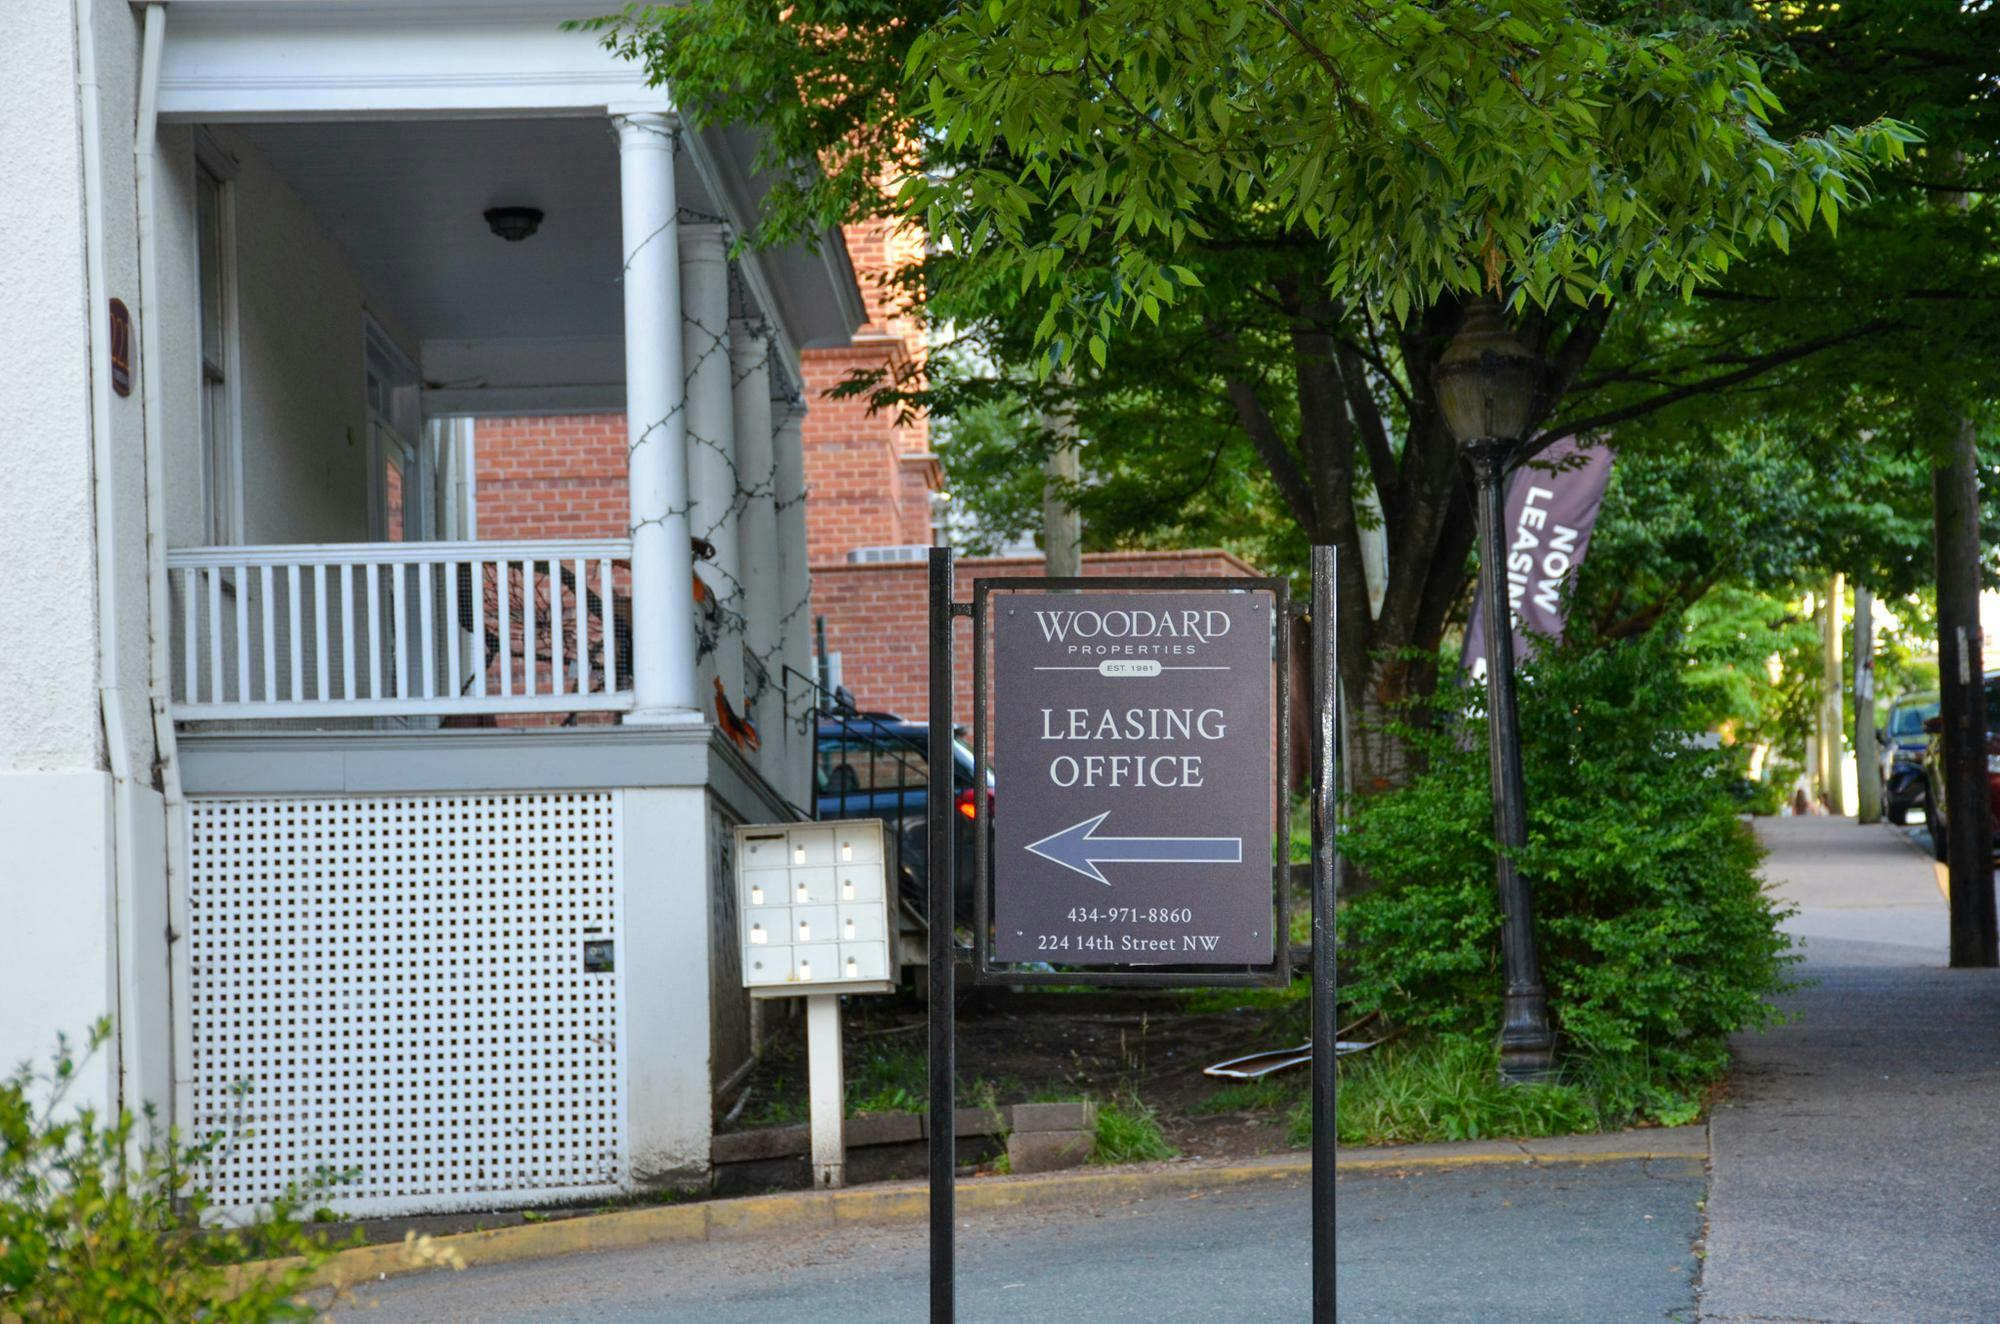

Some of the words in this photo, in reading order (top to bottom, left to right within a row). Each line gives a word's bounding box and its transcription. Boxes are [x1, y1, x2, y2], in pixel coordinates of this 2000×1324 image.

[1506, 485, 1554, 631] LEASIN
[1532, 524, 1579, 615] NOW
[1034, 610, 1231, 644] WOODARD
[1068, 645, 1196, 655] PROPERTIES
[1106, 664, 1128, 672] EST.
[1131, 664, 1154, 672] 1981
[1040, 708, 1228, 740] LEASING
[1049, 755, 1204, 788] OFFICE
[1067, 907, 1192, 923] 434-971-8860
[1038, 935, 1069, 950] 224
[1077, 935, 1115, 950] 14th
[1121, 935, 1176, 951] Street
[1182, 935, 1220, 951] NW
